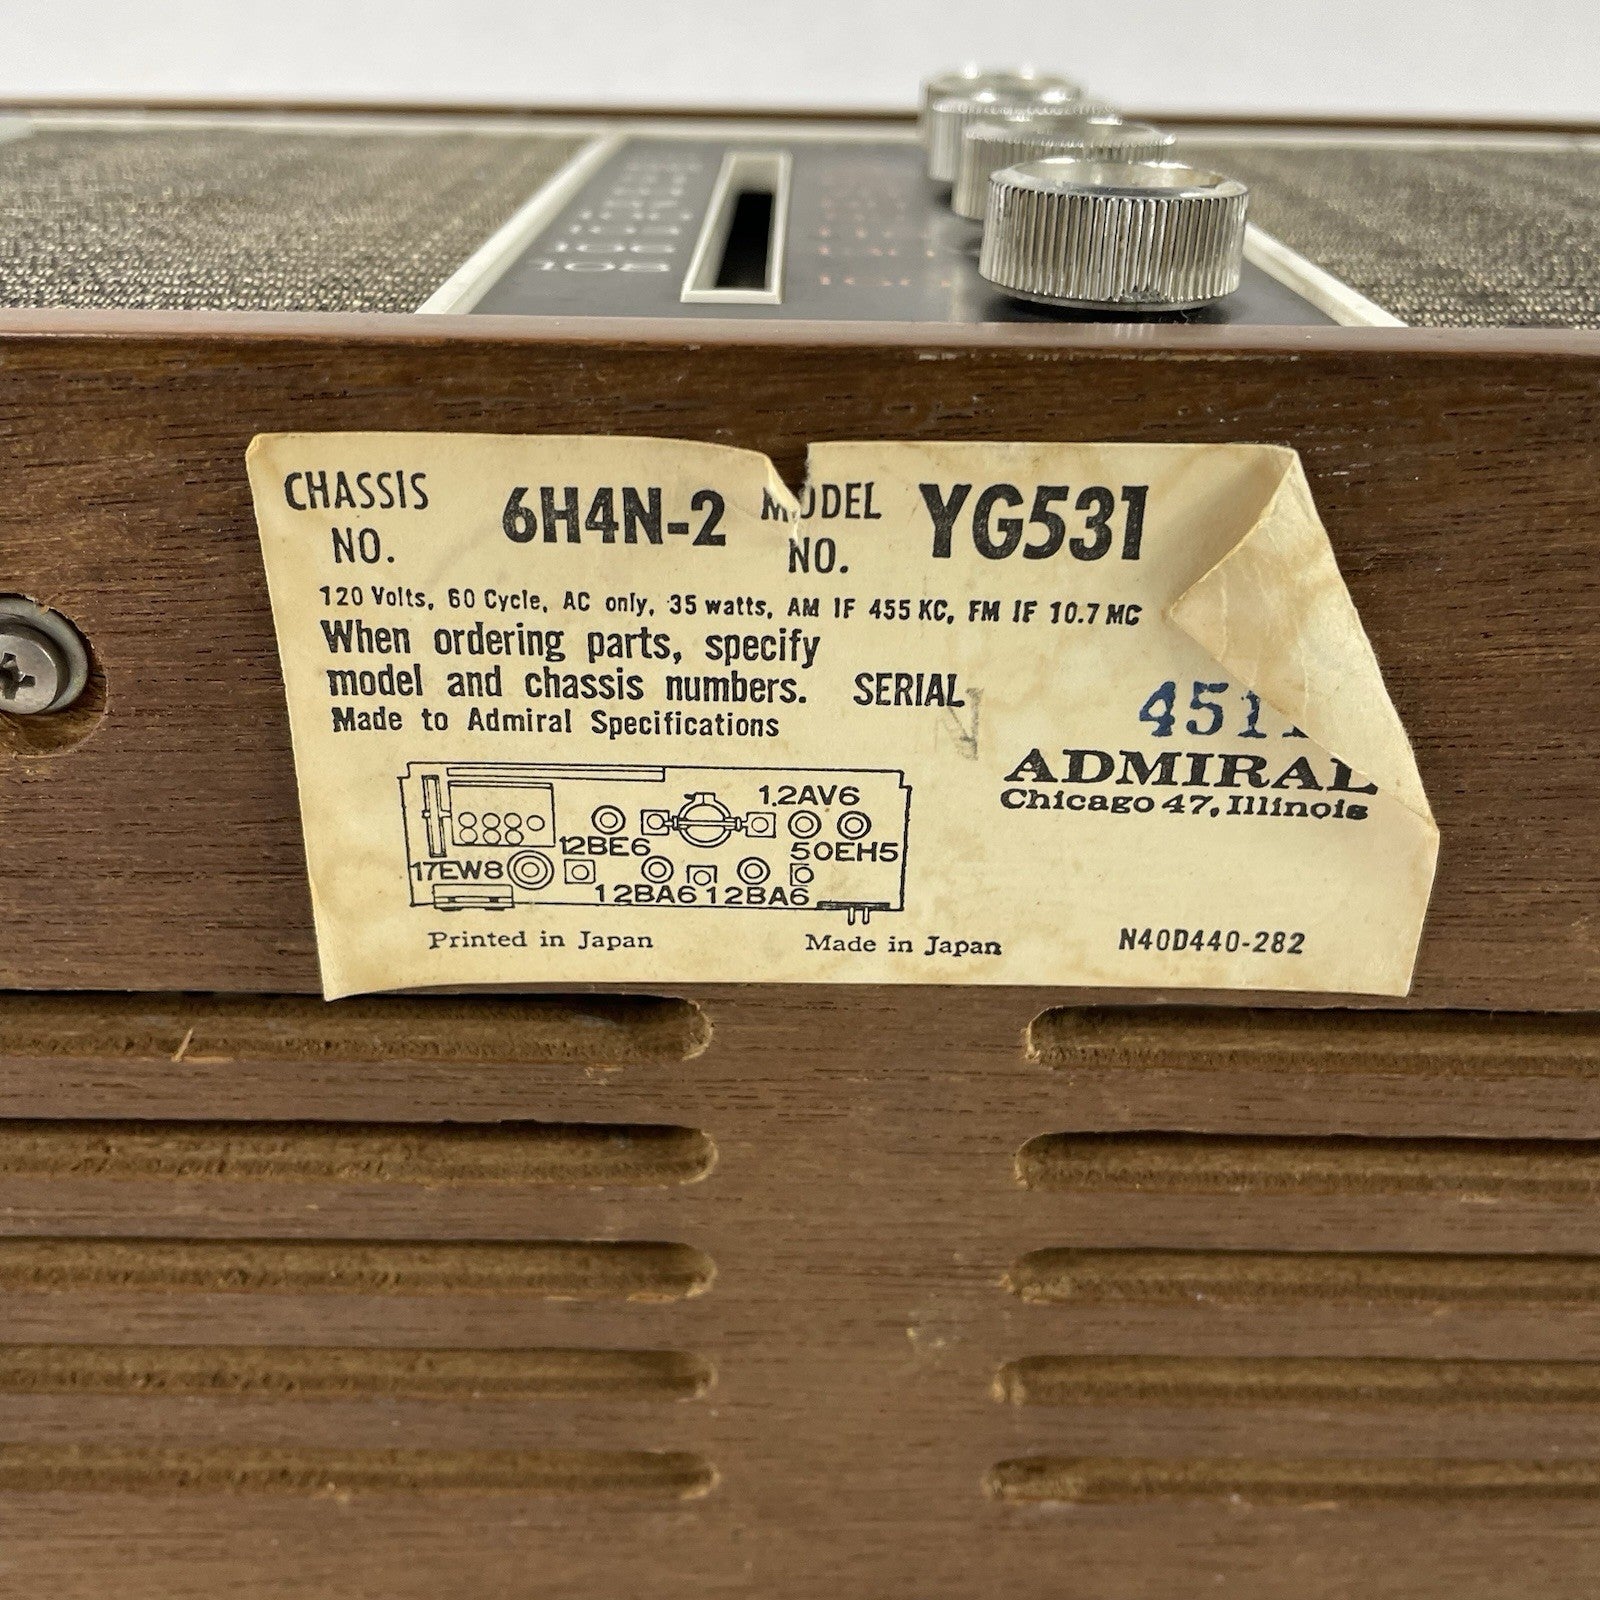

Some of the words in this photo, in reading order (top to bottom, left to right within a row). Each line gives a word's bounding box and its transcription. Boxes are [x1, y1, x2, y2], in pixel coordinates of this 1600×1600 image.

[284, 471, 429, 511] CHASSIS
[502, 486, 727, 547] 6H4N-2
[918, 483, 1149, 561] YG531
[333, 526, 396, 565] NO.
[788, 536, 849, 574] NO.
[319, 586, 363, 606] 120
[371, 585, 434, 610] Volts,
[447, 588, 475, 609] 60
[484, 588, 548, 613] Cycle,
[563, 590, 591, 612] AC
[605, 592, 655, 617] only,
[669, 594, 698, 615] 35
[705, 596, 773, 619] watts,
[787, 597, 820, 618] AM
[834, 597, 856, 619] IF
[868, 598, 911, 620] 455
[918, 598, 955, 625] KC,
[968, 599, 1000, 622] FM
[1013, 600, 1038, 623] IF
[1050, 601, 1100, 625] 10.7
[1105, 603, 1143, 626] MC
[320, 619, 412, 653] When
[433, 621, 566, 663] ordering
[587, 626, 682, 664] parts,
[705, 627, 821, 669] specify
[327, 663, 424, 697] model
[447, 664, 503, 697] and
[525, 665, 645, 700] chassis
[665, 669, 807, 704] numbers.
[853, 672, 965, 708] SERIAL
[331, 706, 403, 733] Made
[421, 707, 448, 731] to
[467, 706, 572, 733] Admiral
[591, 709, 780, 740] Specifications
[1138, 680, 1310, 739] 451
[1003, 747, 1379, 796] ADMIRAL
[1001, 788, 1154, 815] Chicago
[1162, 793, 1220, 819] 47,
[1225, 795, 1369, 821] Illinois
[559, 835, 651, 857] 12BE6
[790, 841, 899, 862] 50EH5
[410, 860, 504, 882] 17EW8
[595, 883, 698, 905] 12BA6
[706, 886, 810, 907] 12BA6
[428, 931, 528, 950] Printed
[540, 931, 566, 948] in
[577, 931, 654, 951] Japan
[805, 934, 877, 953] Made
[888, 936, 913, 953] in
[924, 936, 1003, 956] Japan
[1118, 927, 1306, 956] N40D440-282
